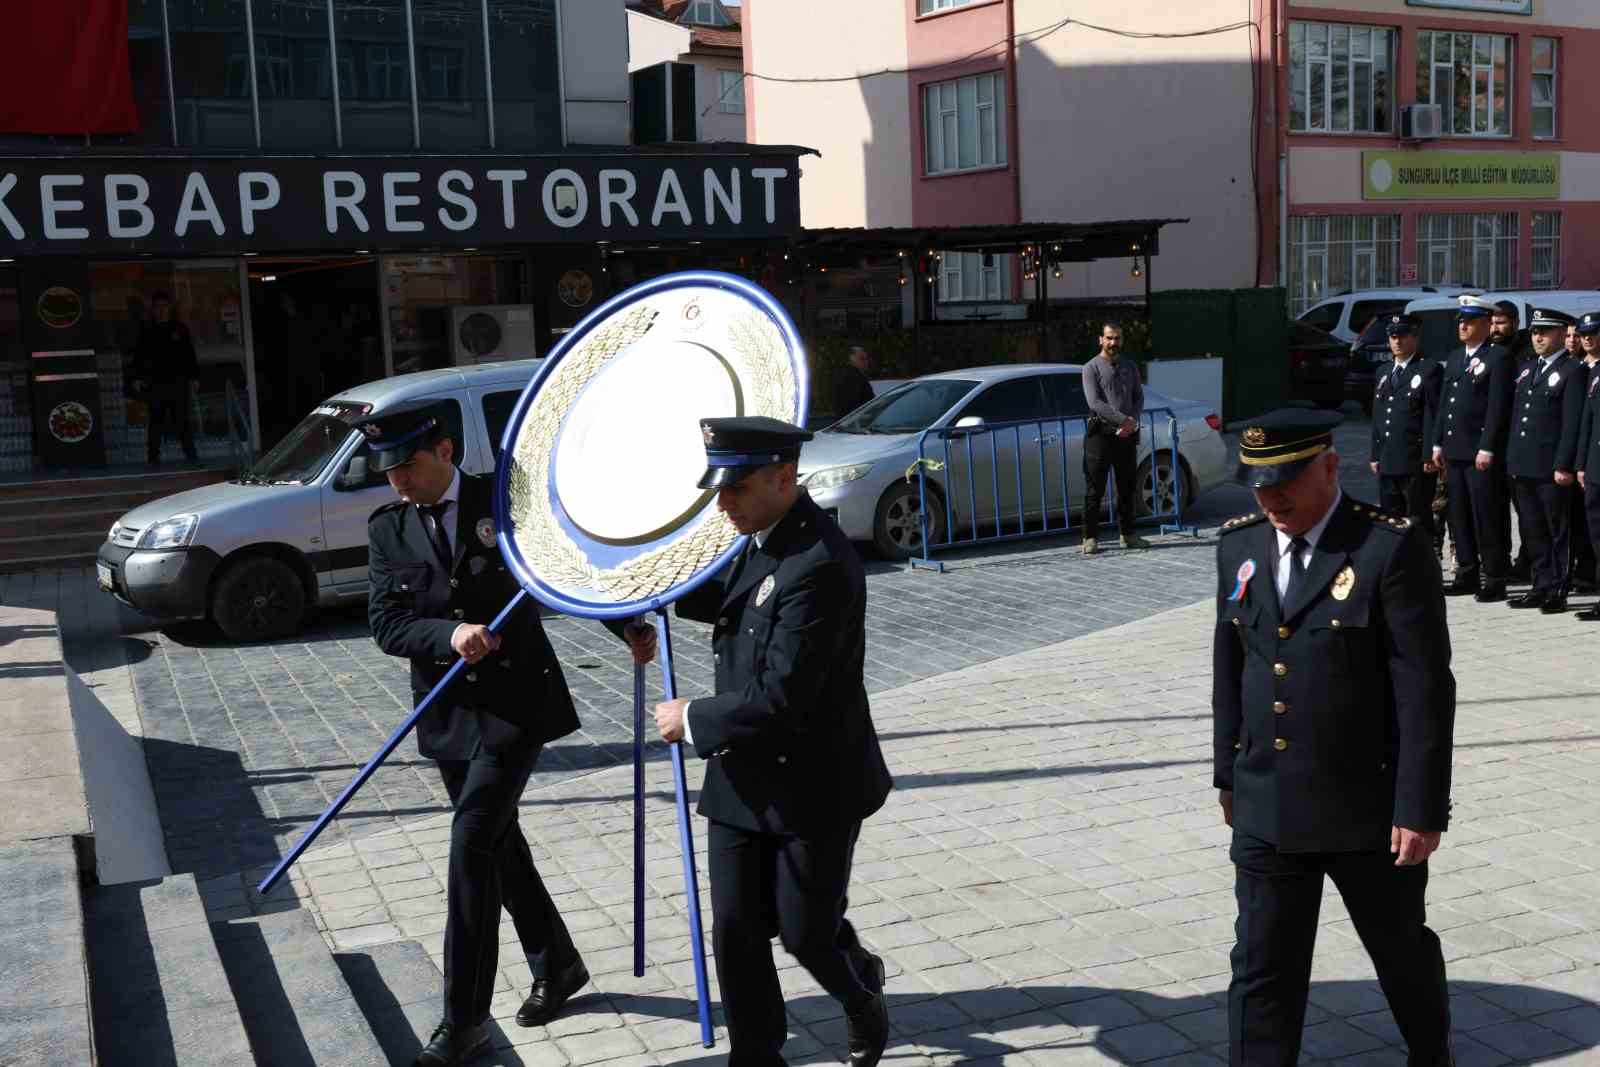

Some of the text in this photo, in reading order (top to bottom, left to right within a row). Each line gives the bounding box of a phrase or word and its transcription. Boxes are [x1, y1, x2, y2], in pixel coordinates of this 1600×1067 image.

[1398, 167, 1441, 185] SUNGURLU
[1442, 165, 1459, 188] İLÇE
[0, 167, 788, 241] KEBAP RESTORANT
